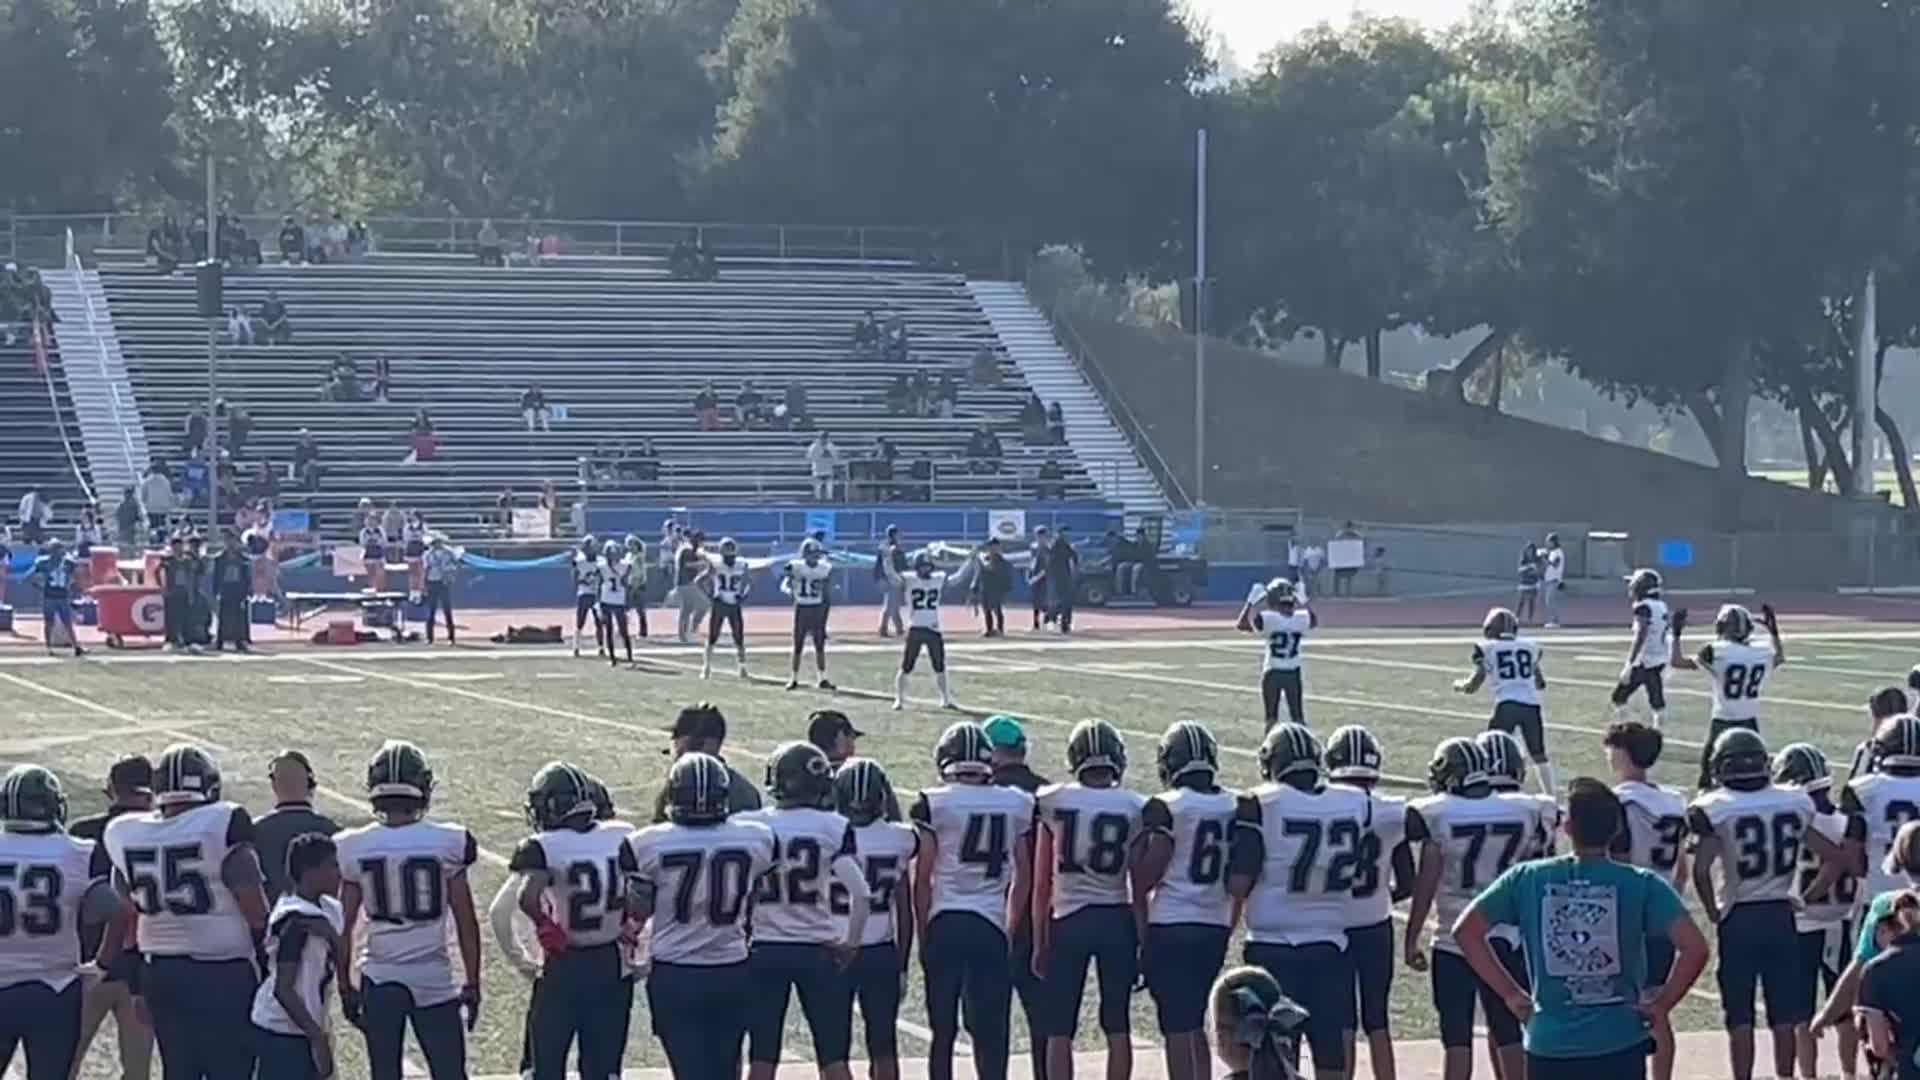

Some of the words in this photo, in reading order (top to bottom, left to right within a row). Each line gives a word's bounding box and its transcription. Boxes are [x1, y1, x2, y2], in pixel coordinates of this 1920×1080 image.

[911, 588, 940, 611] 22
[1269, 631, 1303, 659] 21
[1495, 649, 1533, 679] 58
[1724, 664, 1765, 699] 88
[961, 812, 1008, 879] 4
[1055, 809, 1131, 875] 18
[1282, 817, 1362, 893] 72
[1451, 822, 1525, 889] 77
[1736, 812, 1801, 878] 36
[124, 841, 214, 916] 55
[358, 857, 443, 923] 10
[657, 848, 753, 927] 70
